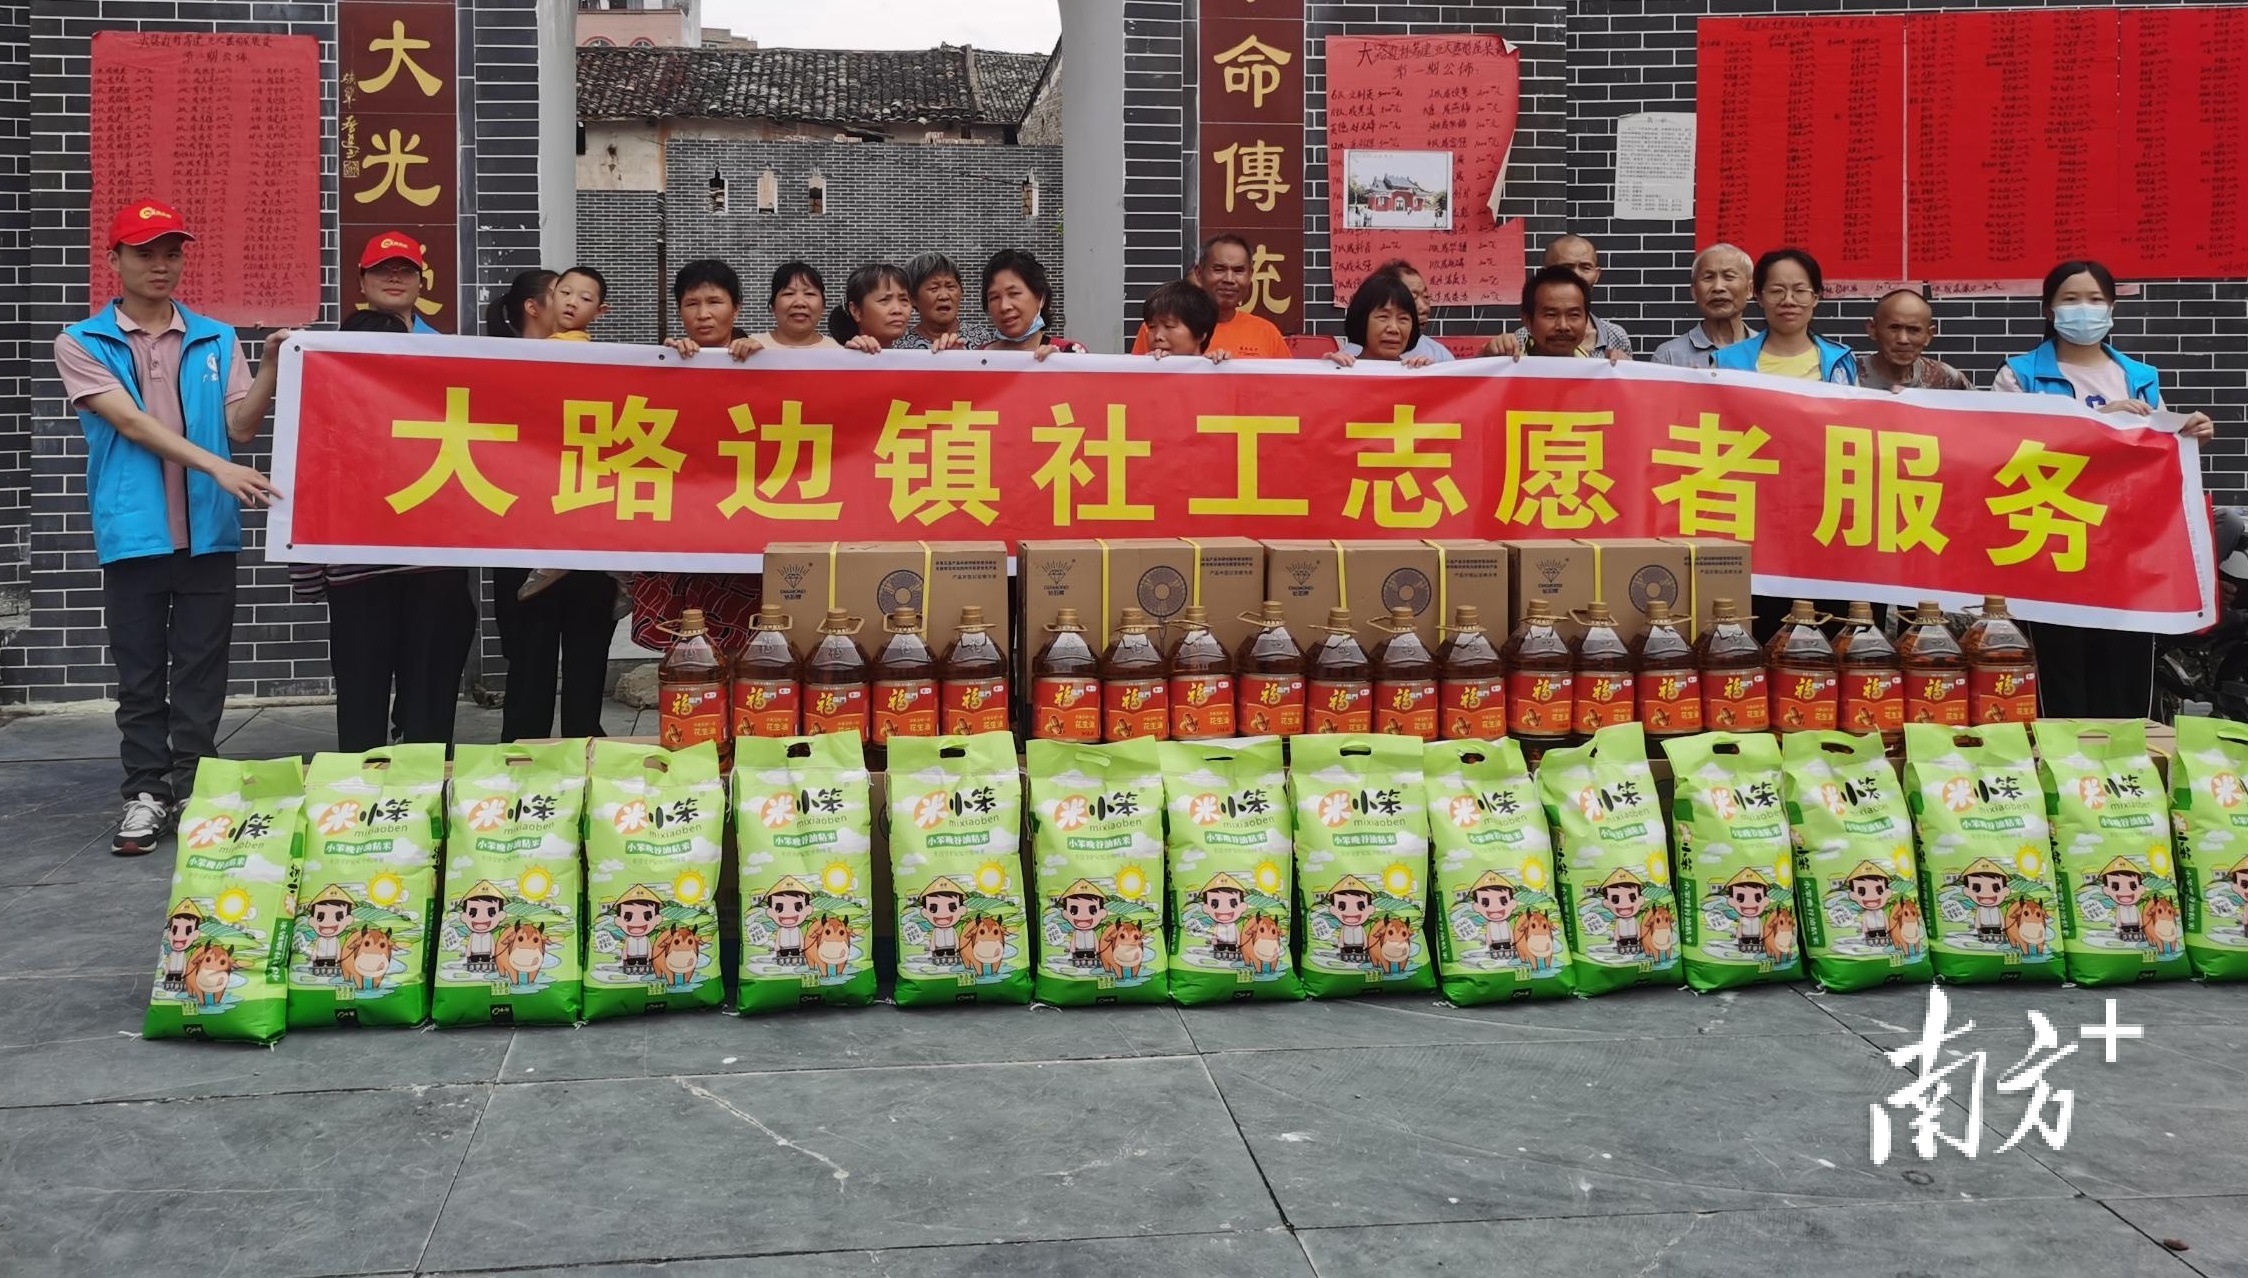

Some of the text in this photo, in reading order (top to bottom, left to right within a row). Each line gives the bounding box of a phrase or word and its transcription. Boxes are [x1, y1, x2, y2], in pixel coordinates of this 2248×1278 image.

[354, 20, 443, 316] 大光
[385, 386, 2107, 573] 大路边镇社工志愿者服务
[796, 815, 847, 828] mixiaoben
[949, 814, 999, 828] mixiaoben
[1089, 819, 1142, 832] mixiaoben
[1223, 816, 1274, 829] mixiaoben
[1353, 818, 1405, 827] mixiaoben
[504, 822, 554, 835] mixiaoben
[649, 824, 702, 838] mixiaoben
